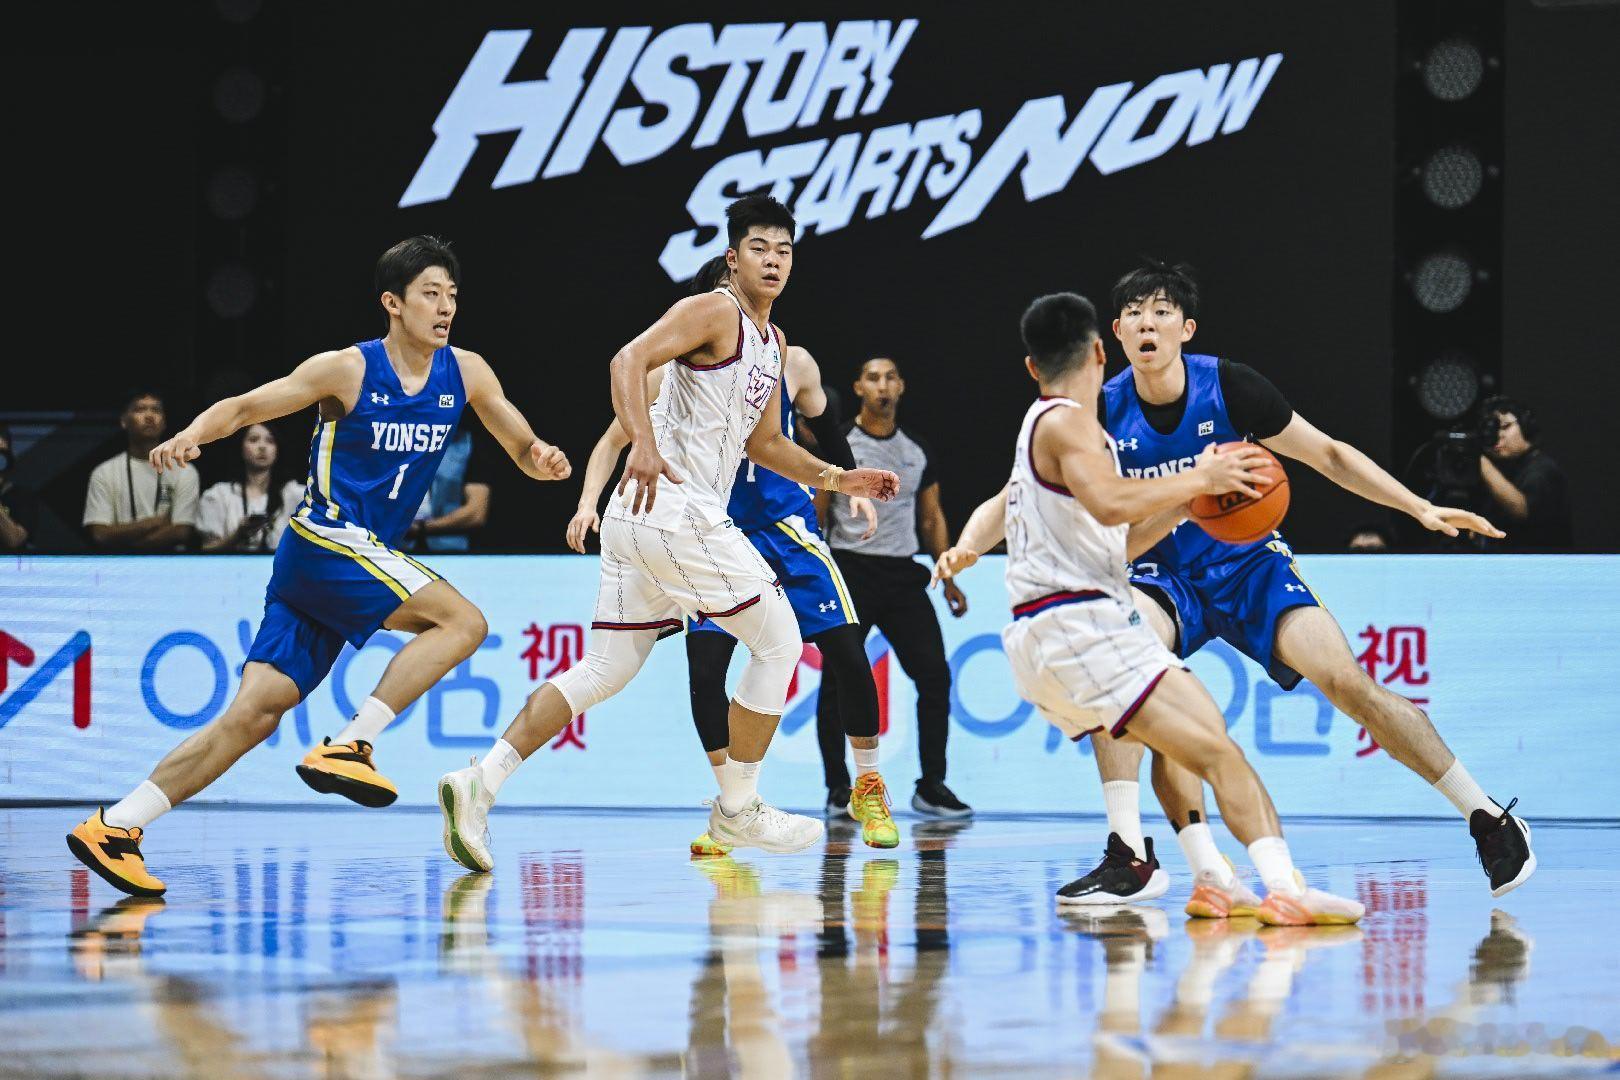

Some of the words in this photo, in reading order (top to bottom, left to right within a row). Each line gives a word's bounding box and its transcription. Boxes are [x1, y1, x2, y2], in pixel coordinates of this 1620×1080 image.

[398, 18, 918, 208] HISTORY
[658, 109, 981, 283] STARTS
[921, 52, 1283, 240] NOW
[388, 463, 409, 500] 1
